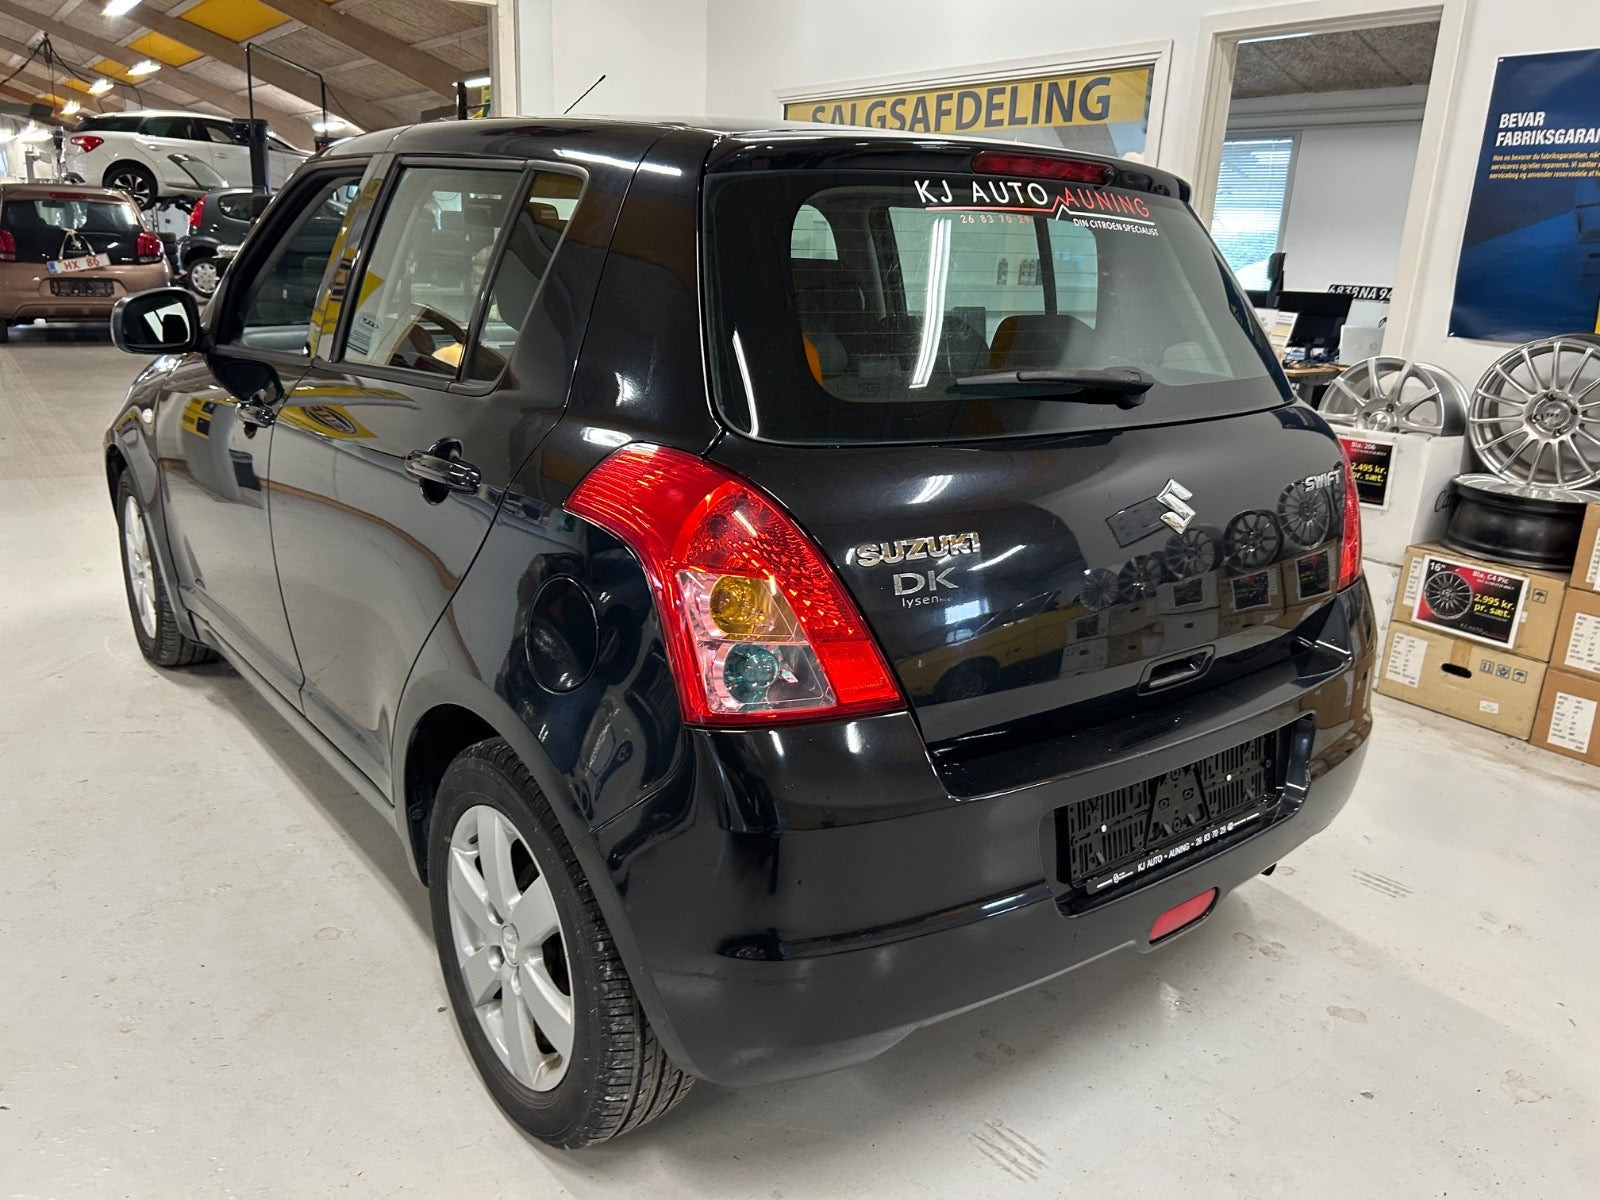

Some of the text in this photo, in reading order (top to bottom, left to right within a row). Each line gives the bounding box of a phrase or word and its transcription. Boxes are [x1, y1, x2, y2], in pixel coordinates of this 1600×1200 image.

[811, 76, 1112, 133] SALGSAFDELING
[1499, 111, 1546, 129] BEVAR
[914, 179, 1049, 206] KJ AUTO
[1063, 187, 1150, 218] AUNING
[960, 214, 975, 224] 26
[980, 214, 994, 224] 83
[1073, 218, 1089, 228] DIN
[1122, 224, 1159, 237] SPECIALIST
[1351, 462, 1387, 475] 2.495 kr.
[1305, 469, 1341, 492] SWIFT
[856, 532, 980, 567] SUZUKI
[892, 567, 959, 596] DK
[1473, 593, 1515, 610] 2.995 kr.
[1473, 604, 1488, 613] pr.
[1137, 862, 1146, 872] KJ
[1146, 854, 1163, 868] AUTO
[1168, 842, 1190, 858] AUNING
